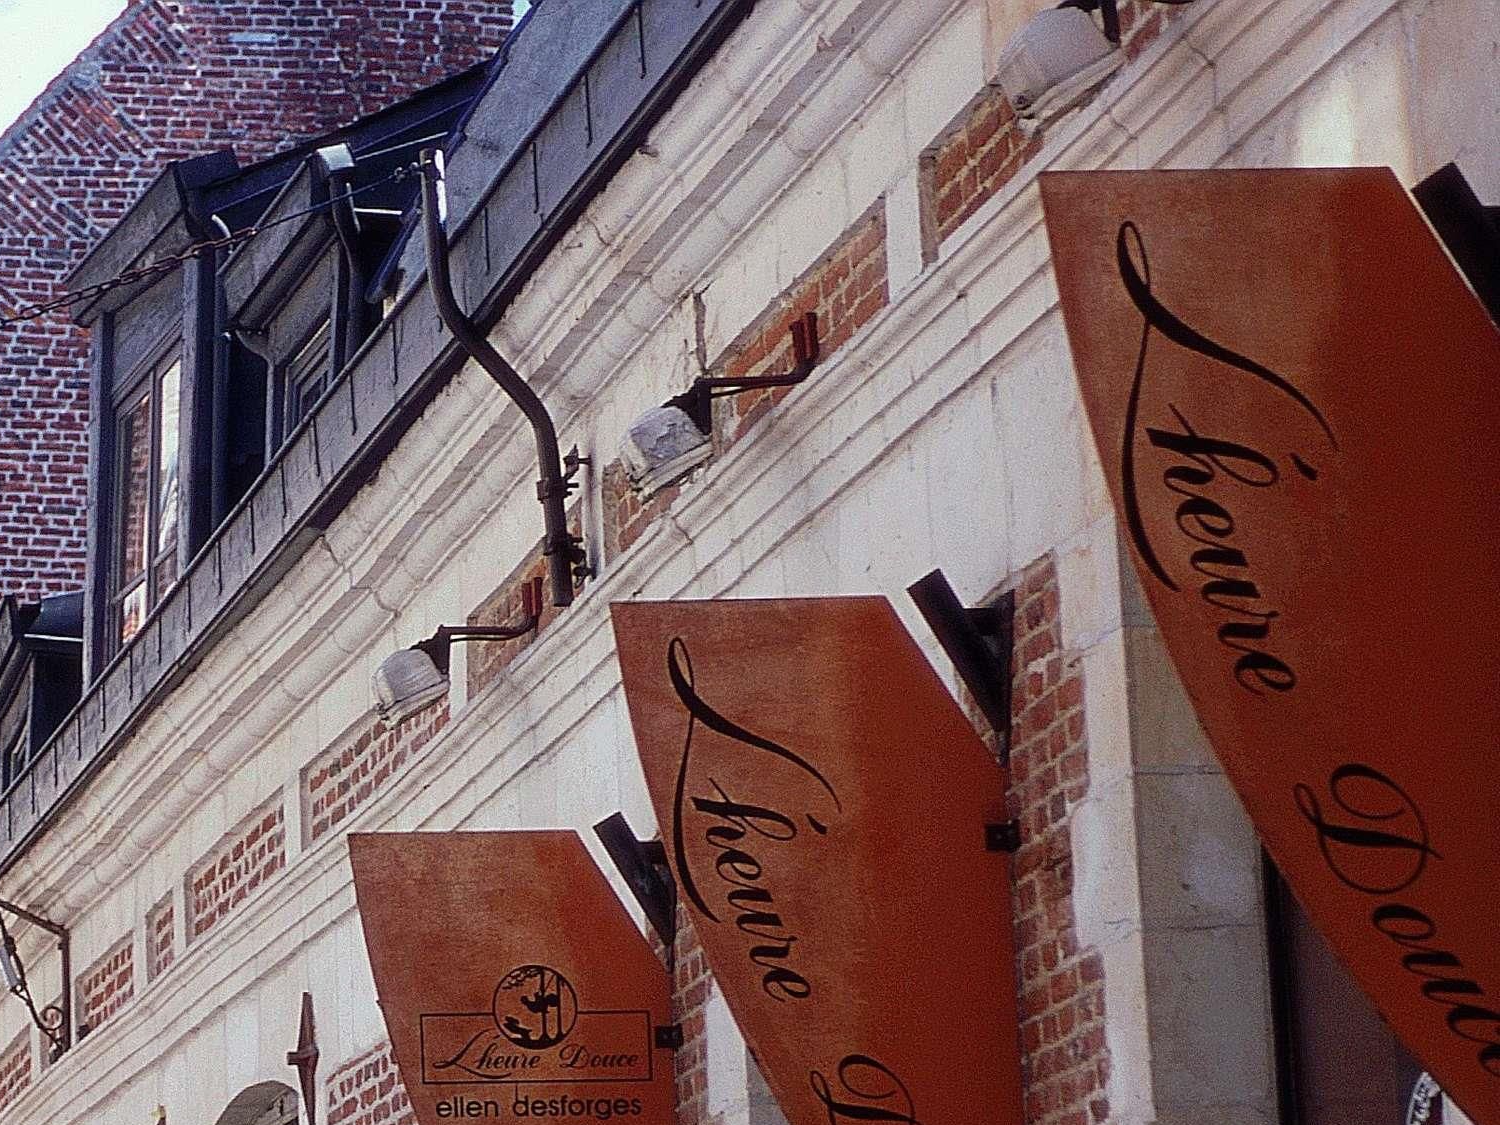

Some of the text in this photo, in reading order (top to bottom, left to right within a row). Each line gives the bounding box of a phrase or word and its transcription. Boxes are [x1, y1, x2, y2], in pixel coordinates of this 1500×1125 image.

[1116, 221, 1338, 697] L'heure
[668, 637, 842, 1002] L'heure
[433, 1028, 639, 1079] L'heure Douce
[436, 1095, 642, 1119] ellen desforges
